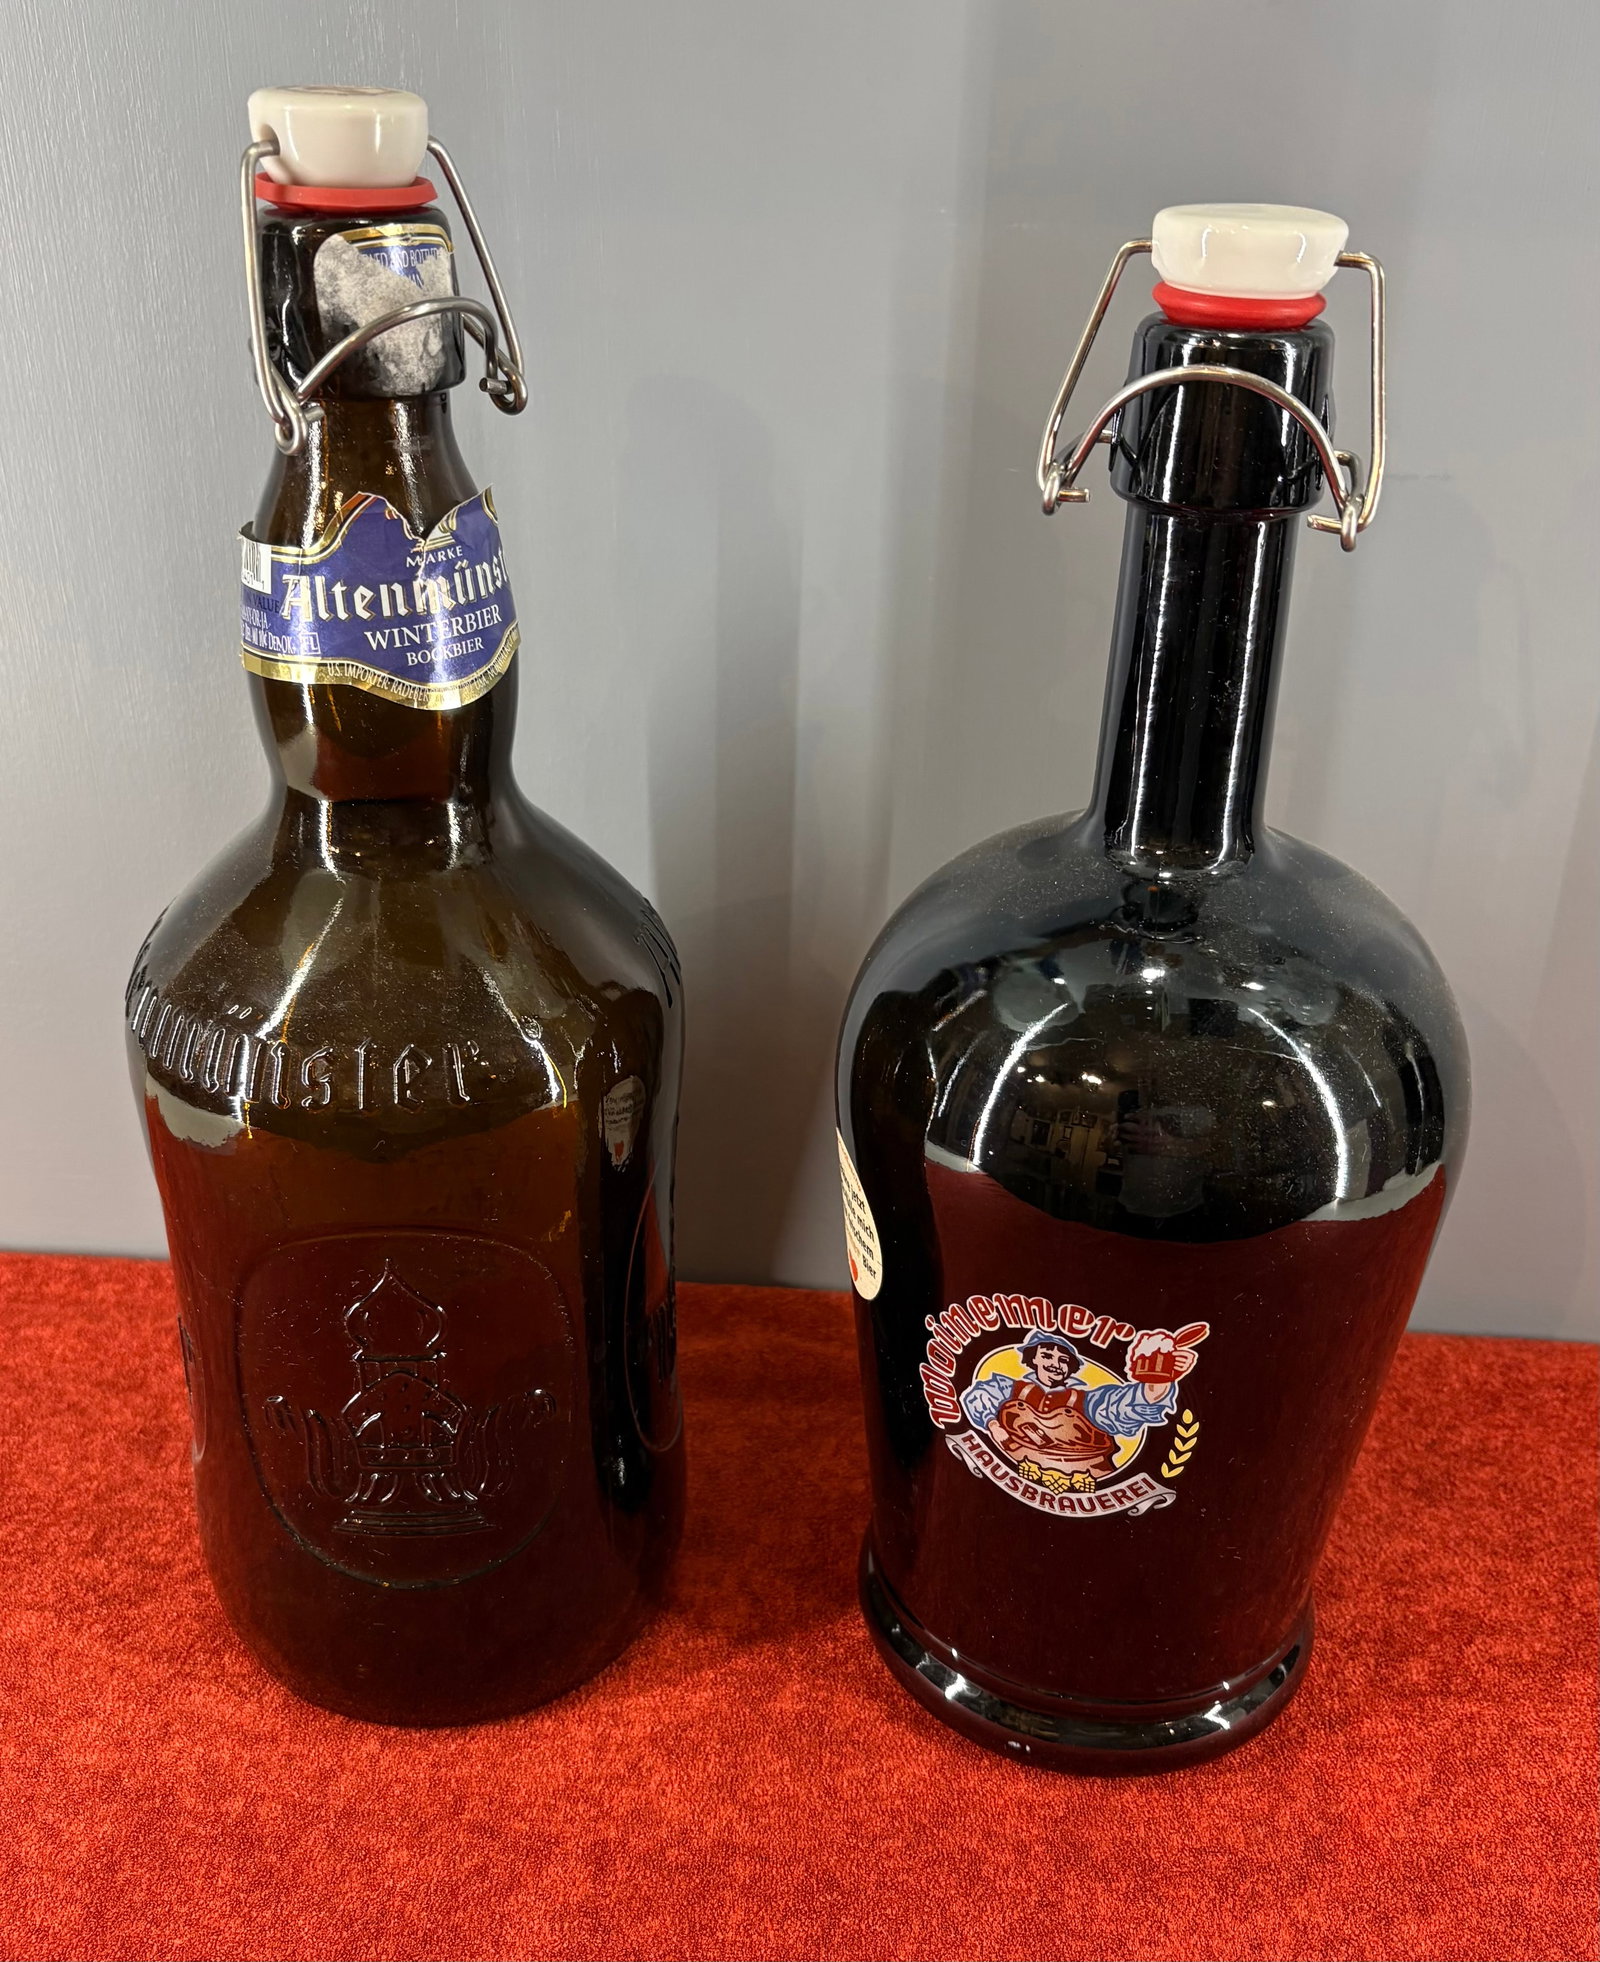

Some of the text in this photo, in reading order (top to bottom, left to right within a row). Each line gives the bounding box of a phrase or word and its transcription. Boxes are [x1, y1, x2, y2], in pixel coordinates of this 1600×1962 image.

[406, 546, 463, 568] MARKE
[253, 594, 280, 614] VALUE
[364, 603, 503, 651] WINTERBIER
[406, 637, 484, 667] BOCKBIER
[857, 1213, 875, 1243] mich
[862, 1254, 877, 1280] Bier
[961, 1433, 1157, 1515] HAUSBRAUEREI
